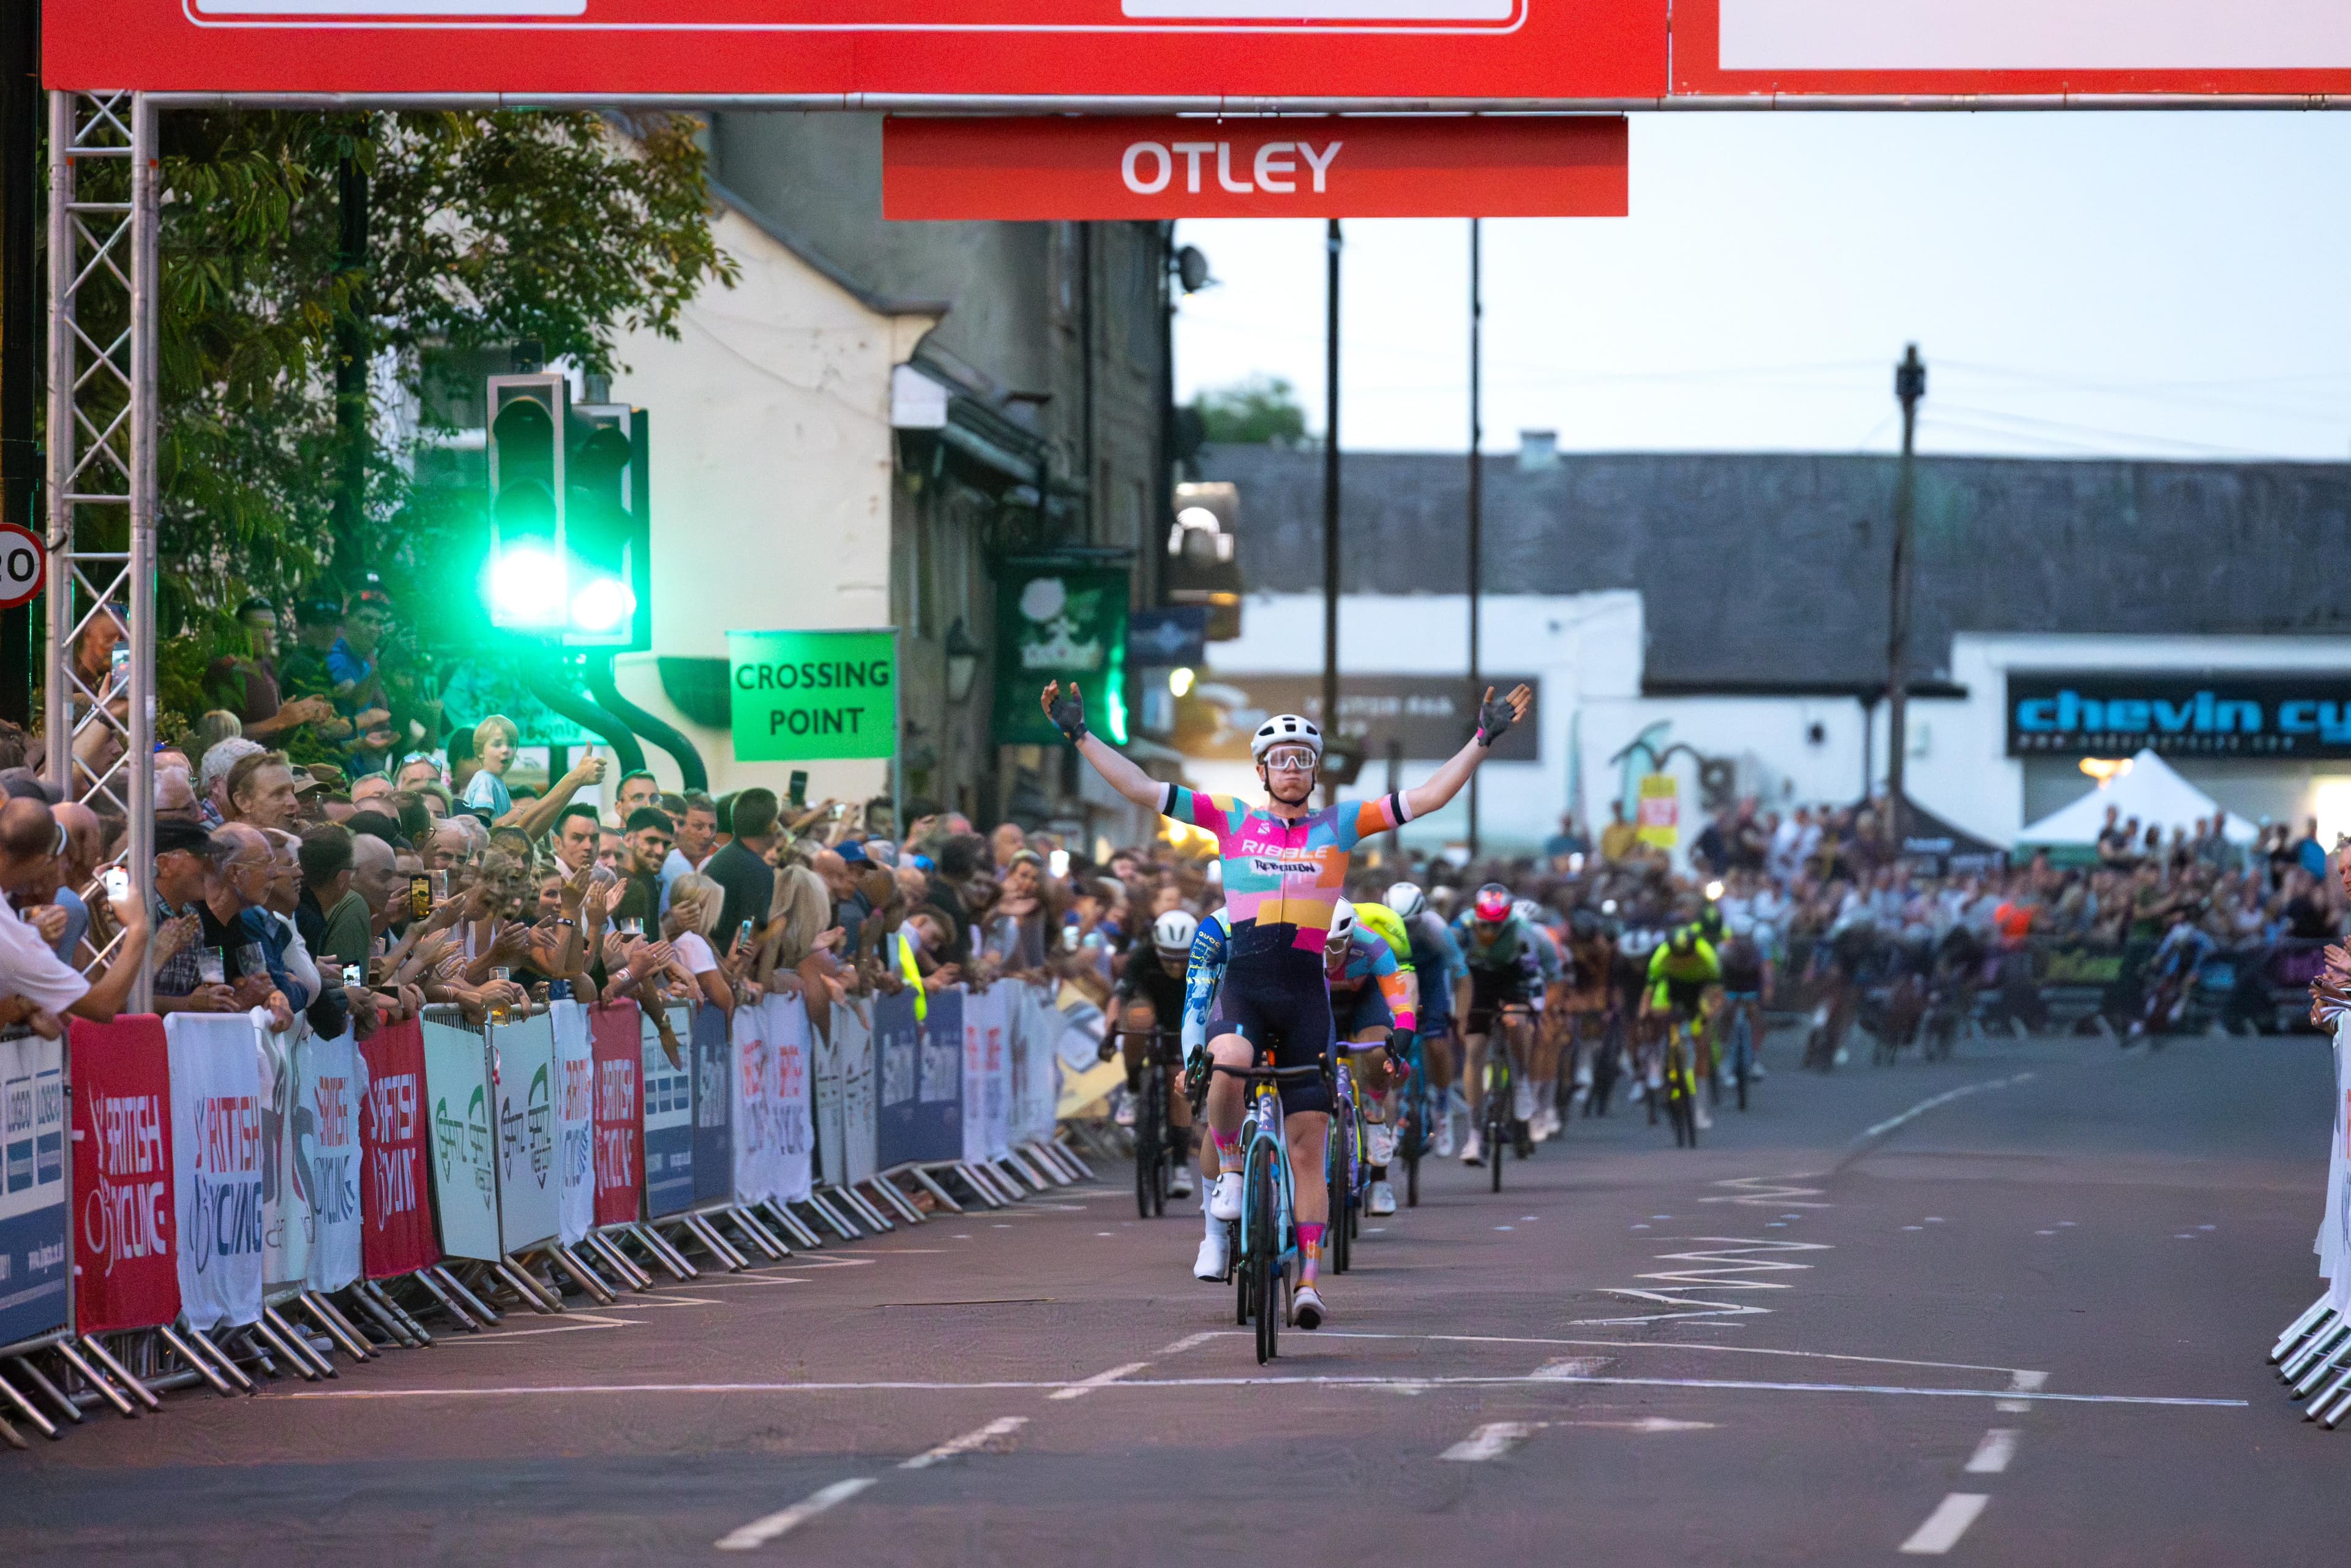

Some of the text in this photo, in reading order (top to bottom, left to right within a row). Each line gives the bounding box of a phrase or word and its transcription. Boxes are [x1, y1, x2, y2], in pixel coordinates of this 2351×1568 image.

[1121, 141, 1343, 195] OTLEY
[0, 547, 35, 582] 0
[737, 661, 889, 689] CROSSING
[770, 708, 864, 735] POINT
[2017, 689, 2262, 732] chevin
[1241, 839, 1330, 858] RIBBLE
